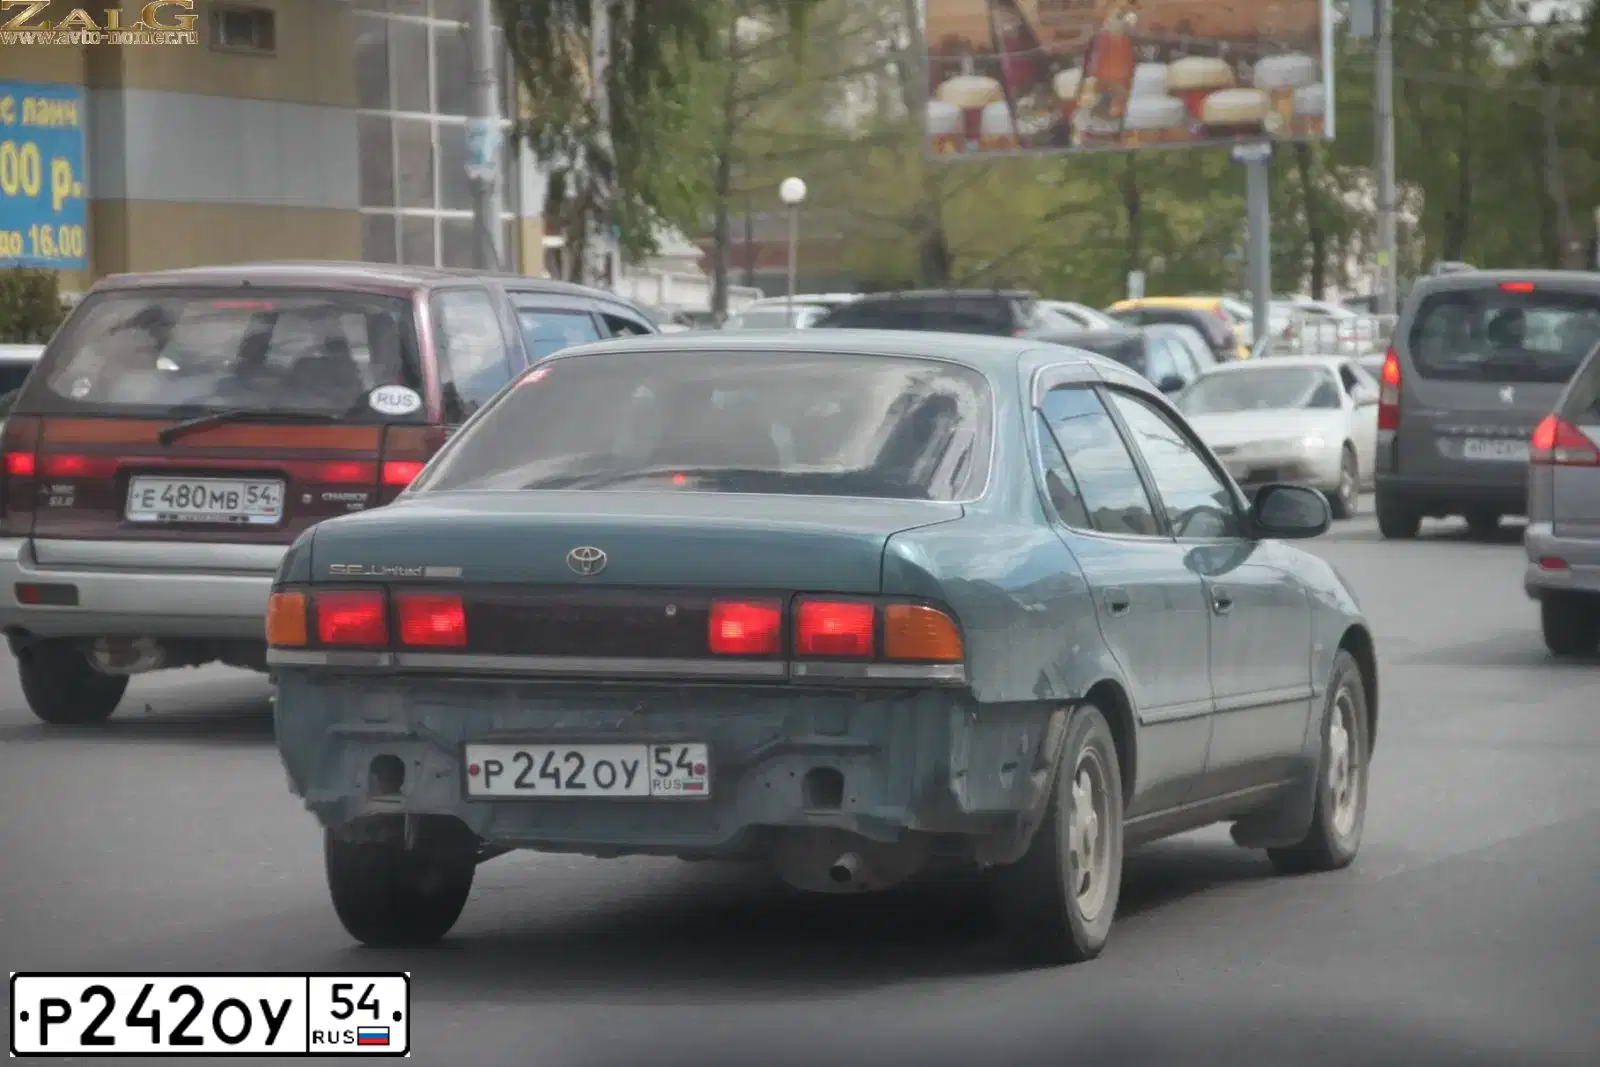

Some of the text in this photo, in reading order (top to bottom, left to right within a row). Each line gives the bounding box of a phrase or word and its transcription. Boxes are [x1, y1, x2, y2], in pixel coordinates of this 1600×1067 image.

[28, 223, 84, 258] 16.00
[377, 391, 413, 408] RUS
[247, 486, 272, 505] 54
[654, 747, 693, 777] 54
[652, 778, 682, 790] RUS
